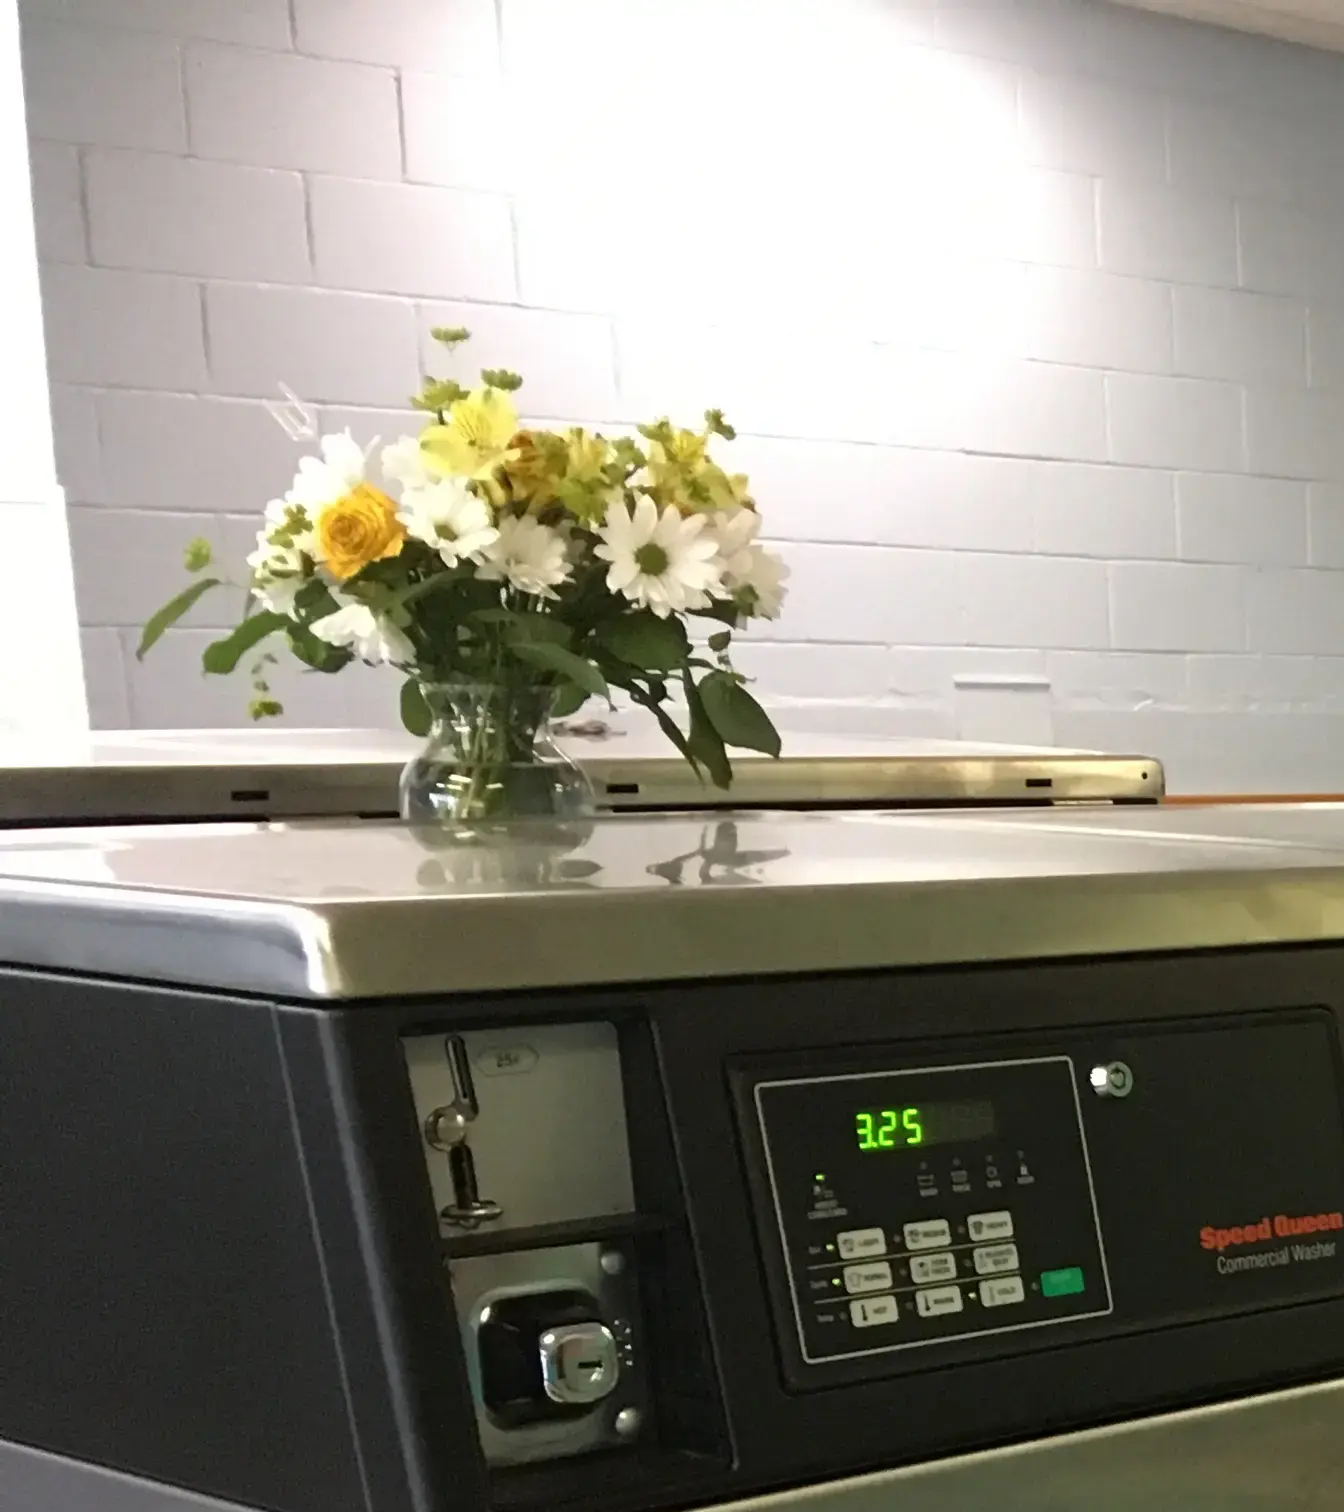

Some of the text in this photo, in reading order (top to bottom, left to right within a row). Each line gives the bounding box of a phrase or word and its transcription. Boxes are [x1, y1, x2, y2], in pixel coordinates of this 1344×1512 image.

[856, 1108, 922, 1149] 3.25
[1200, 1211, 1344, 1253] Speed Queen
[1216, 1241, 1337, 1275] Commercial Washer
